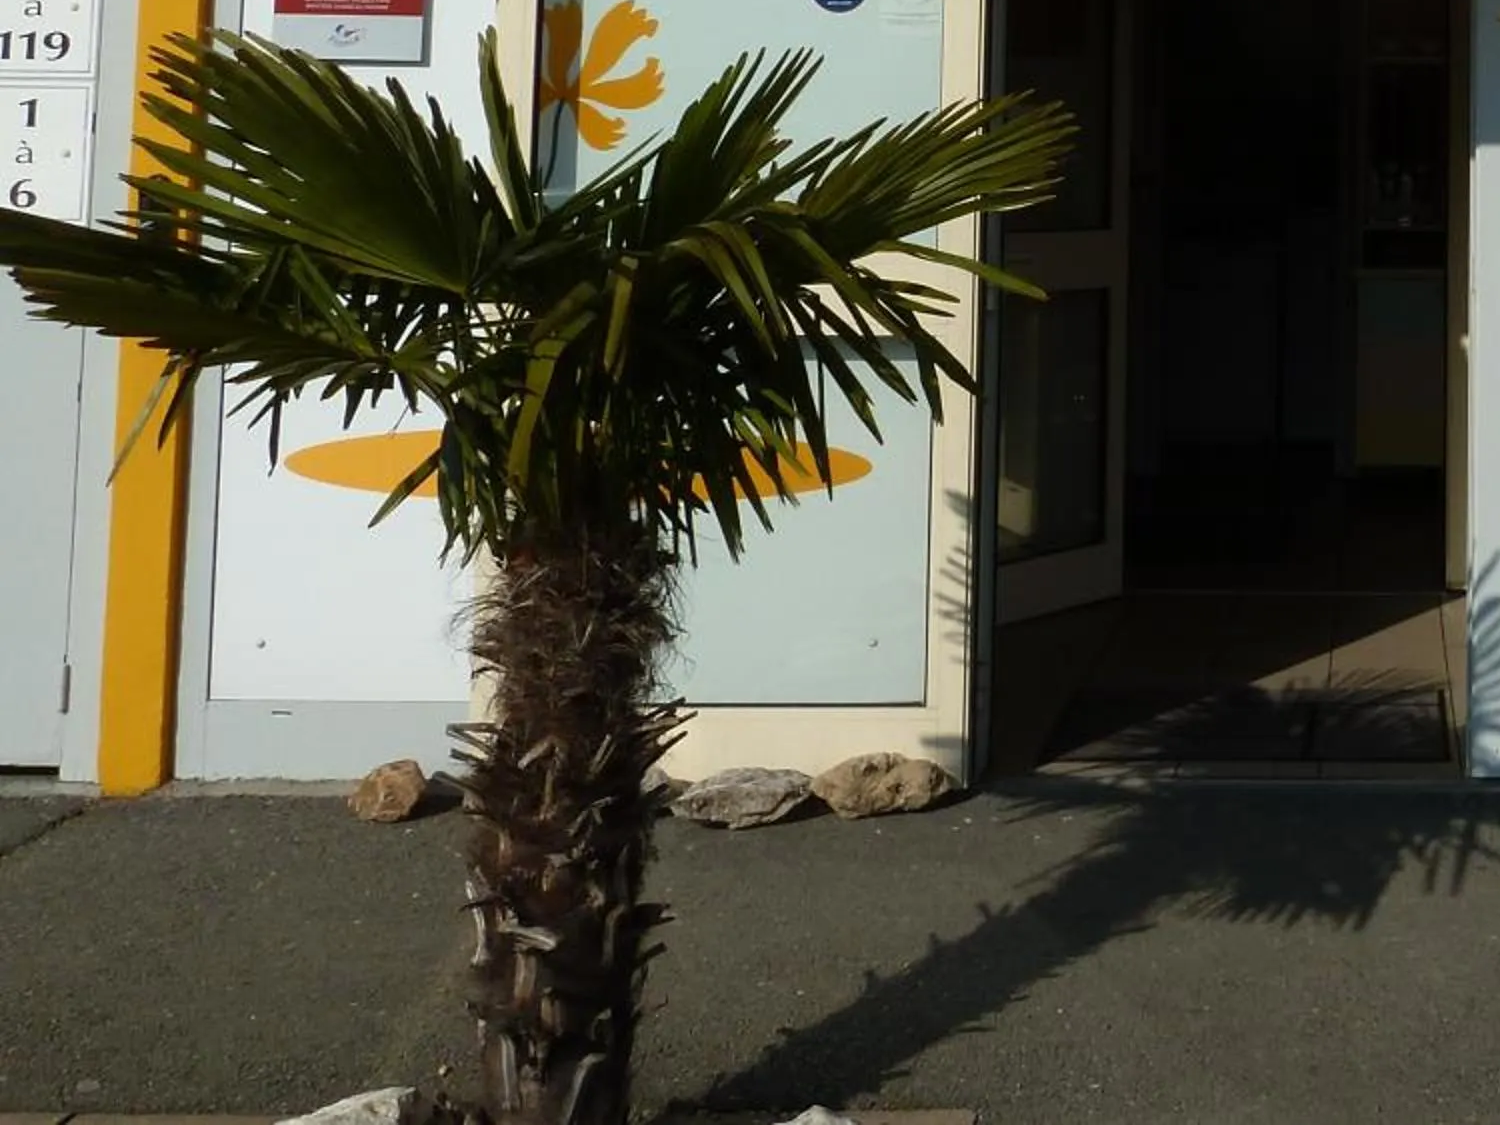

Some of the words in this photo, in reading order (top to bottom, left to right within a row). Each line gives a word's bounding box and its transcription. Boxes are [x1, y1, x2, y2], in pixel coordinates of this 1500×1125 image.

[0, 30, 71, 61] 119
[18, 98, 38, 128] 1
[15, 139, 33, 164] à
[9, 178, 37, 208] 6
